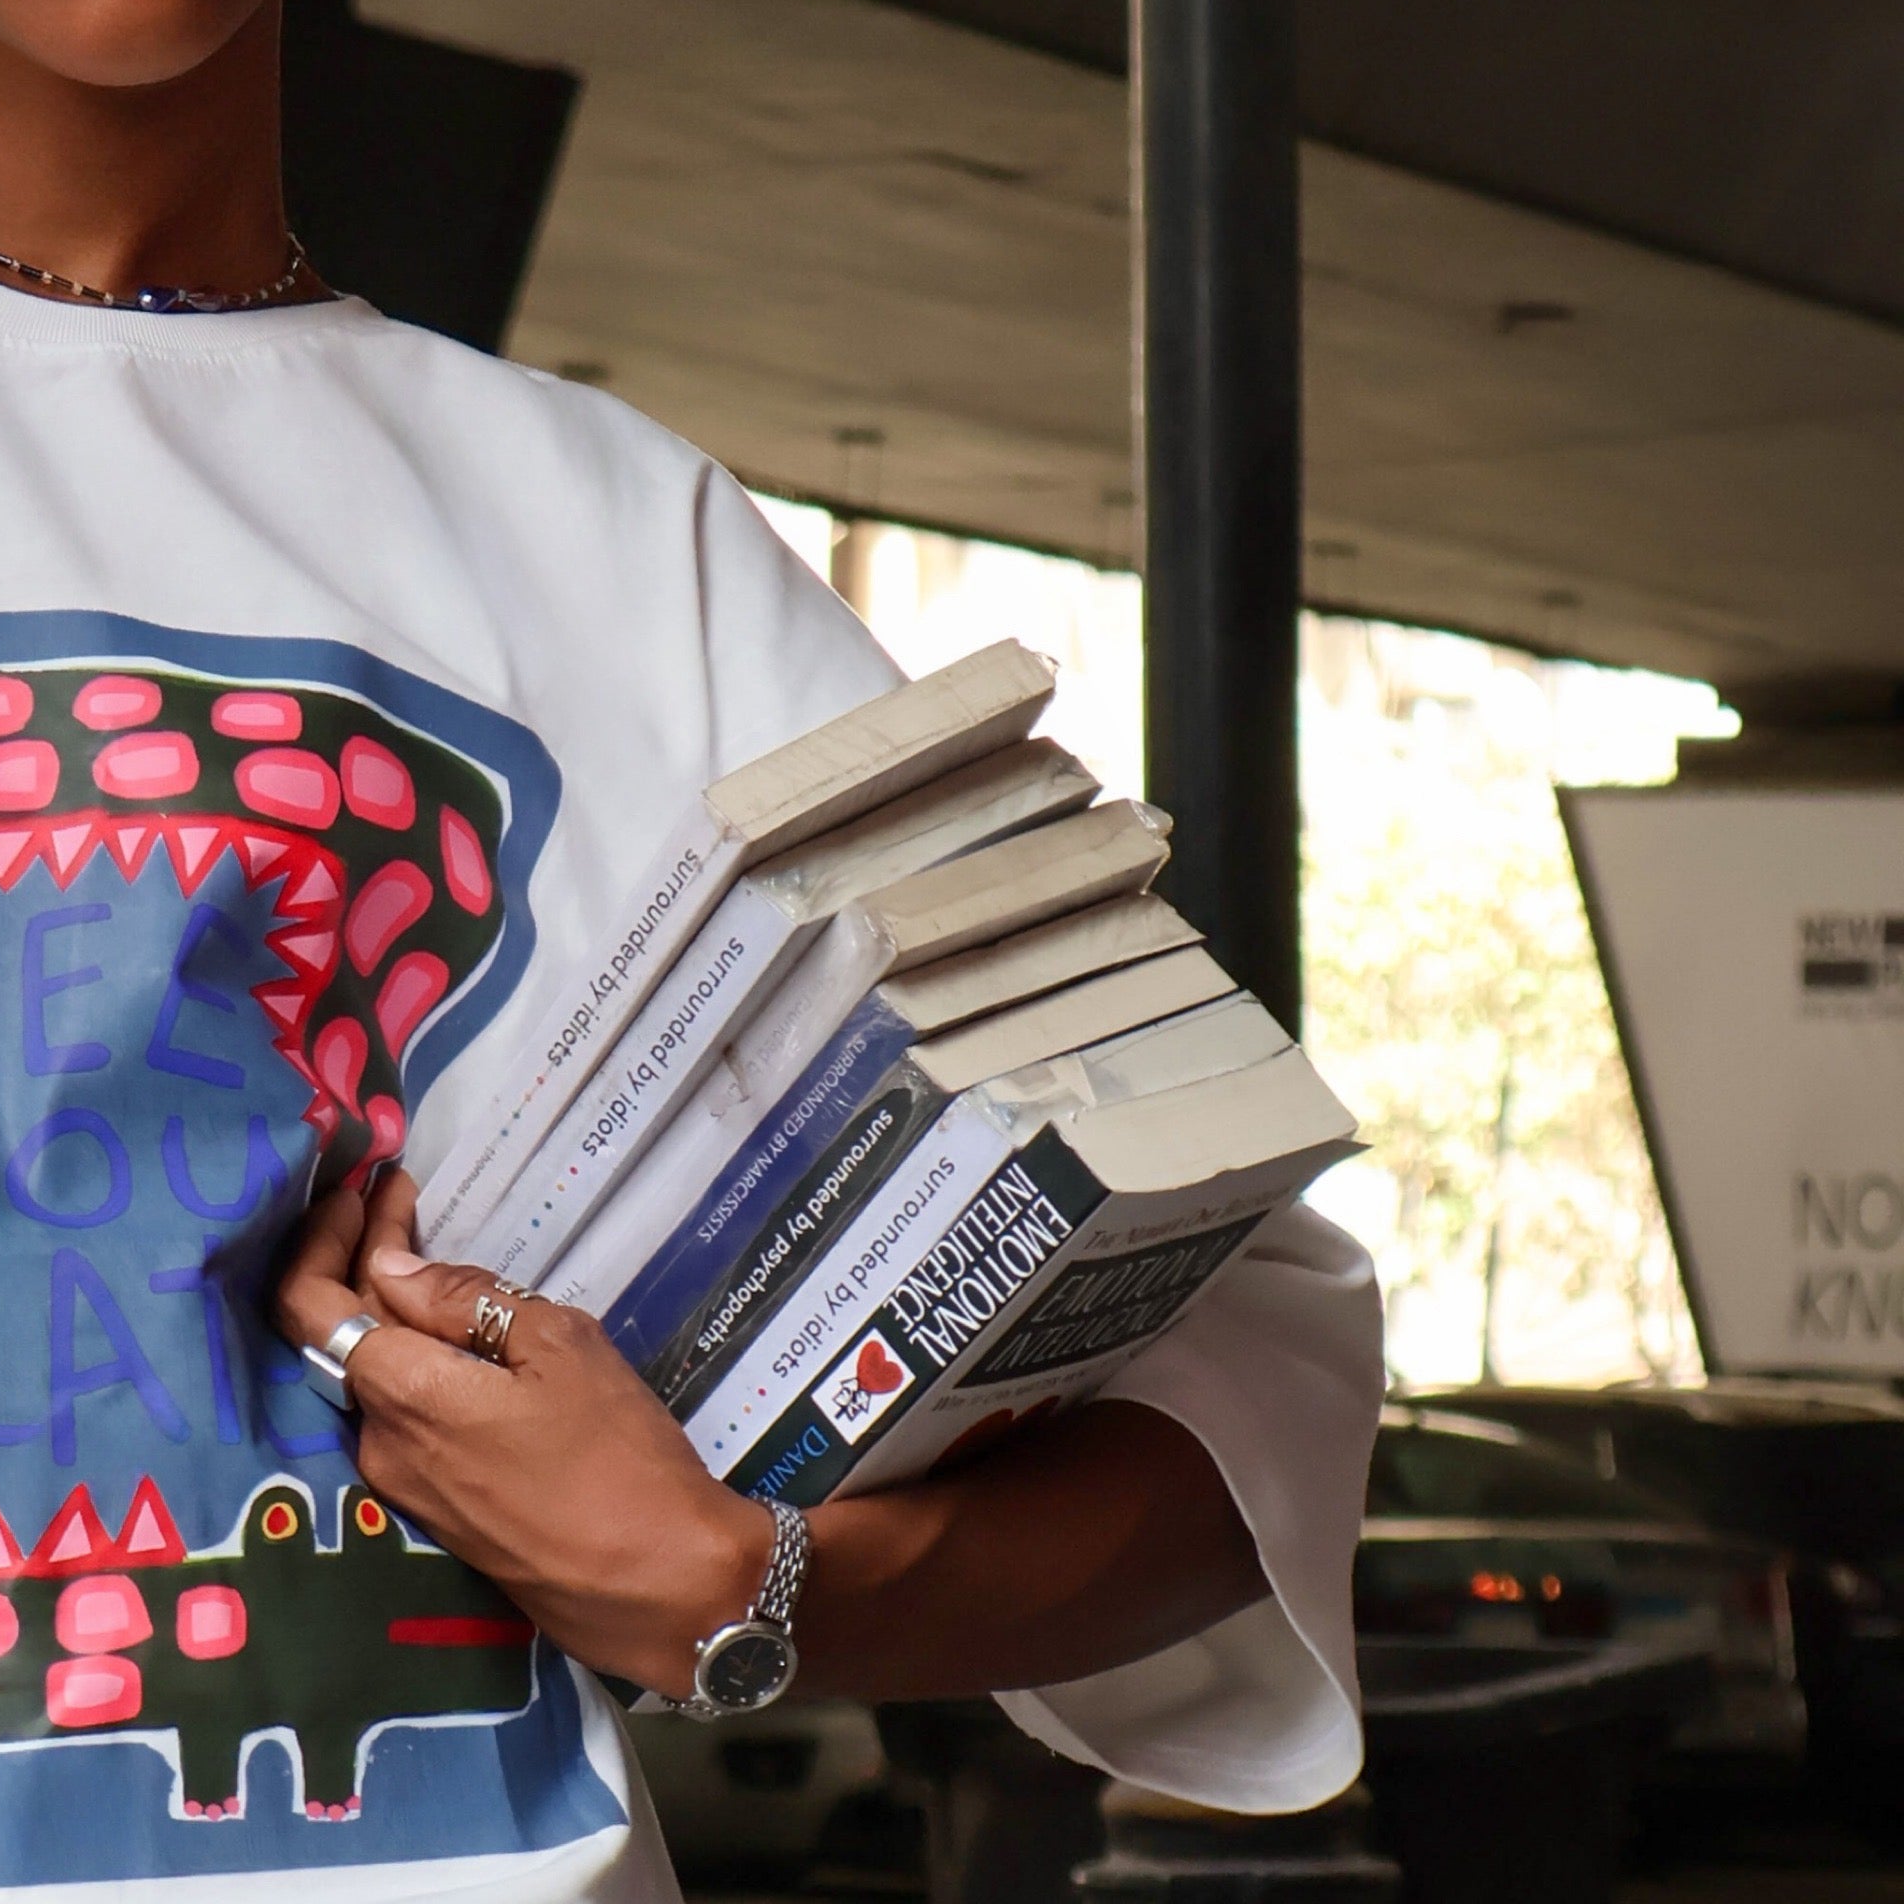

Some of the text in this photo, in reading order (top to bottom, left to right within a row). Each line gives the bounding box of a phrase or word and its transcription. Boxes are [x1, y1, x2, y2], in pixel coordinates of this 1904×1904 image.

[547, 847, 699, 1069] surrounded by idiots
[582, 936, 745, 1159] surrounded by idiots
[697, 1108, 895, 1352] surrounded by psychopaths
[698, 1036, 867, 1244] SURROUNDED BY NARCISSISTS
[882, 1161, 1040, 1334] INTELLIGENCE
[772, 1156, 956, 1378] surrounded by idiots
[908, 1194, 1074, 1368] EMOTIONAL
